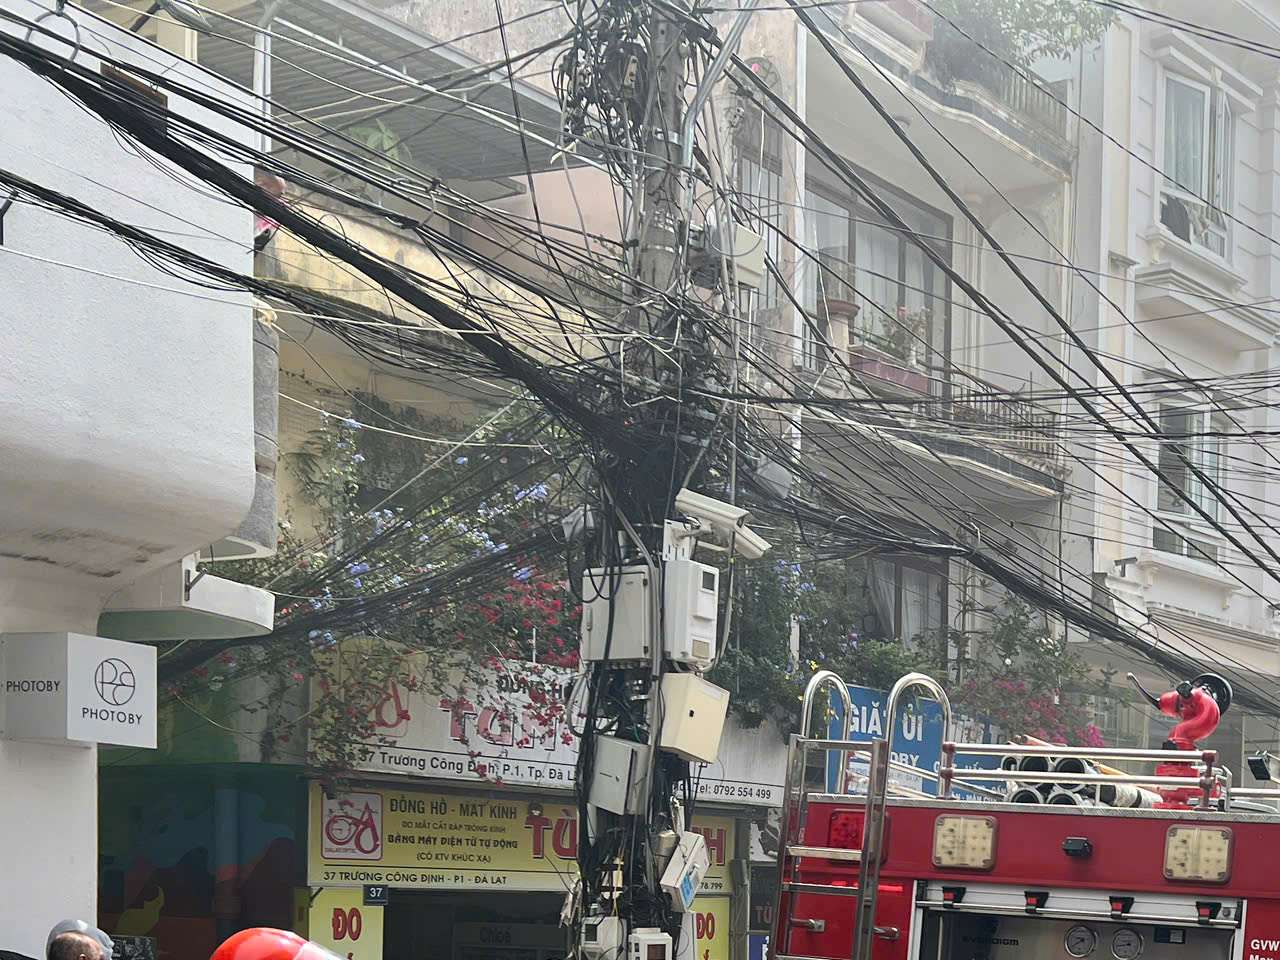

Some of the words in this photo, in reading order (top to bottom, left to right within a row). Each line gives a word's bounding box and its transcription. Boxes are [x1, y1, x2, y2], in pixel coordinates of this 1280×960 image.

[6, 680, 61, 692] PHOTOBY
[82, 707, 142, 725] PHOTOBY
[380, 752, 426, 770] Trương
[431, 757, 463, 774] Công
[528, 766, 545, 780] Tp.
[549, 768, 563, 780] Đà
[713, 785, 735, 797] 0792
[737, 787, 753, 797] 554
[756, 789, 771, 799] 499
[390, 794, 425, 814] ĐỒNG
[430, 797, 447, 815] HỒ
[418, 834, 437, 845] MÁY
[324, 872, 336, 880] 37
[338, 871, 383, 881] TRƯƠNG
[386, 871, 418, 882] CÔNG
[420, 873, 445, 884] ĐỊNH
[454, 874, 464, 883] P1
[474, 873, 488, 884] ĐÀ
[370, 888, 382, 897] 37
[332, 907, 362, 941] ĐO
[696, 912, 716, 940] ĐO
[1250, 939, 1280, 951] GVW
